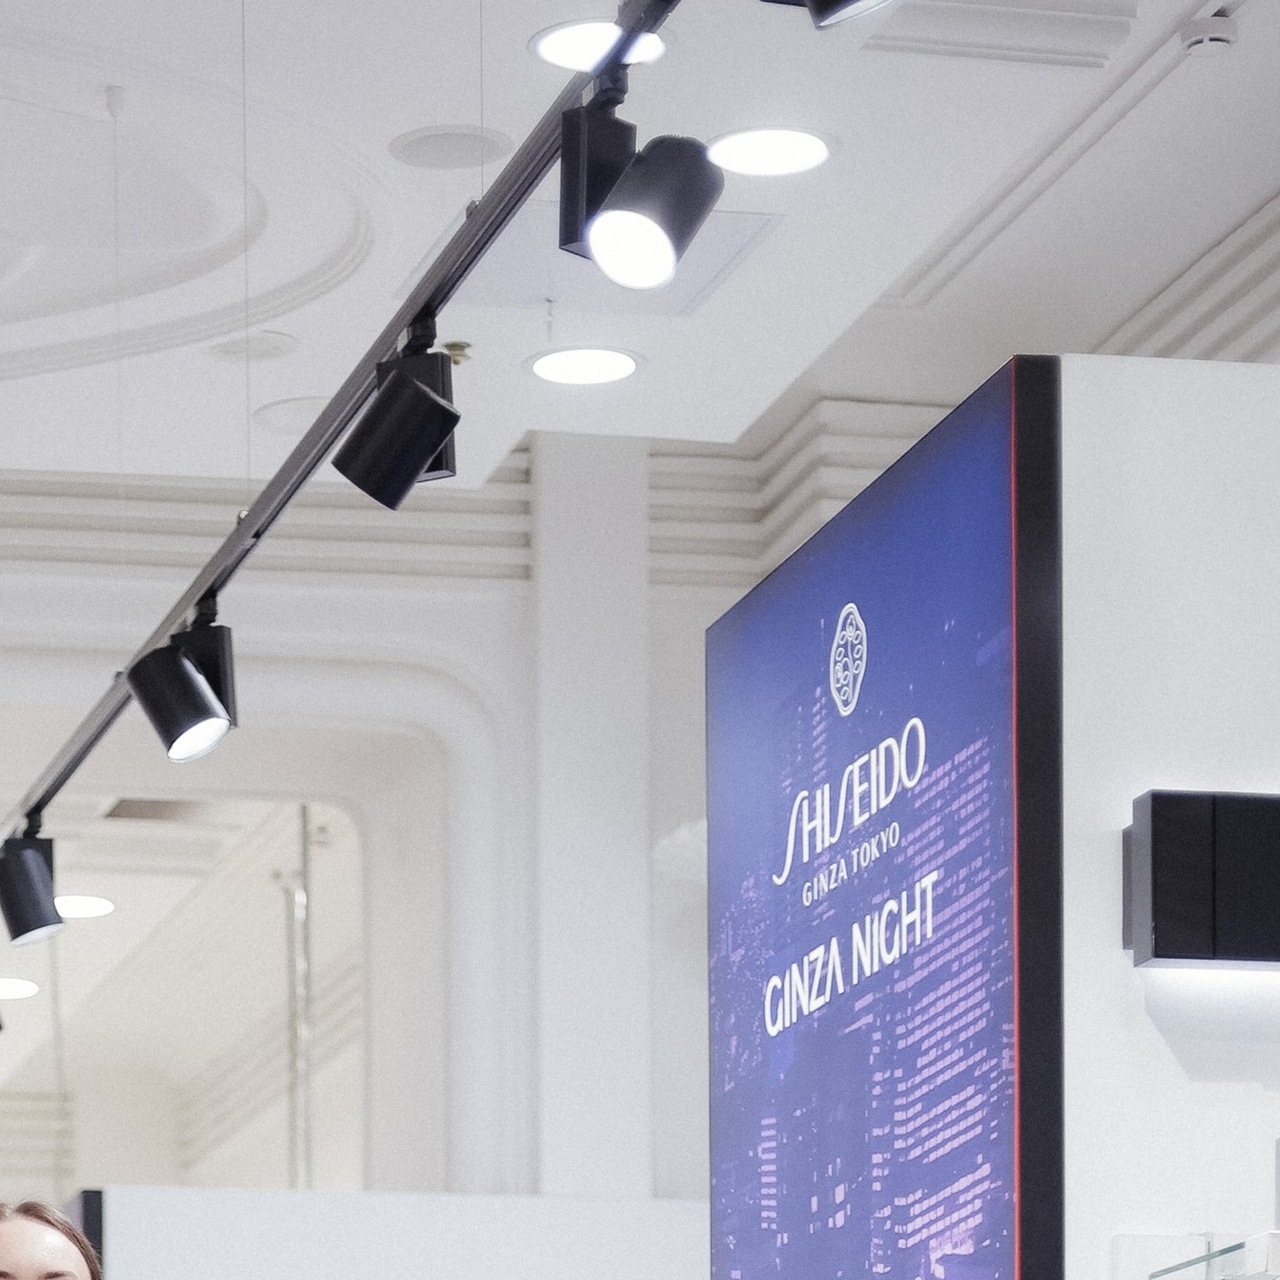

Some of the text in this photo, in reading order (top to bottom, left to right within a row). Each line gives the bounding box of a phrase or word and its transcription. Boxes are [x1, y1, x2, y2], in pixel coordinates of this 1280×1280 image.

[772, 717, 926, 886] SHISEIDO
[802, 821, 900, 907] GINZA TOKYO
[764, 870, 938, 1037] GINZA NIGHT
